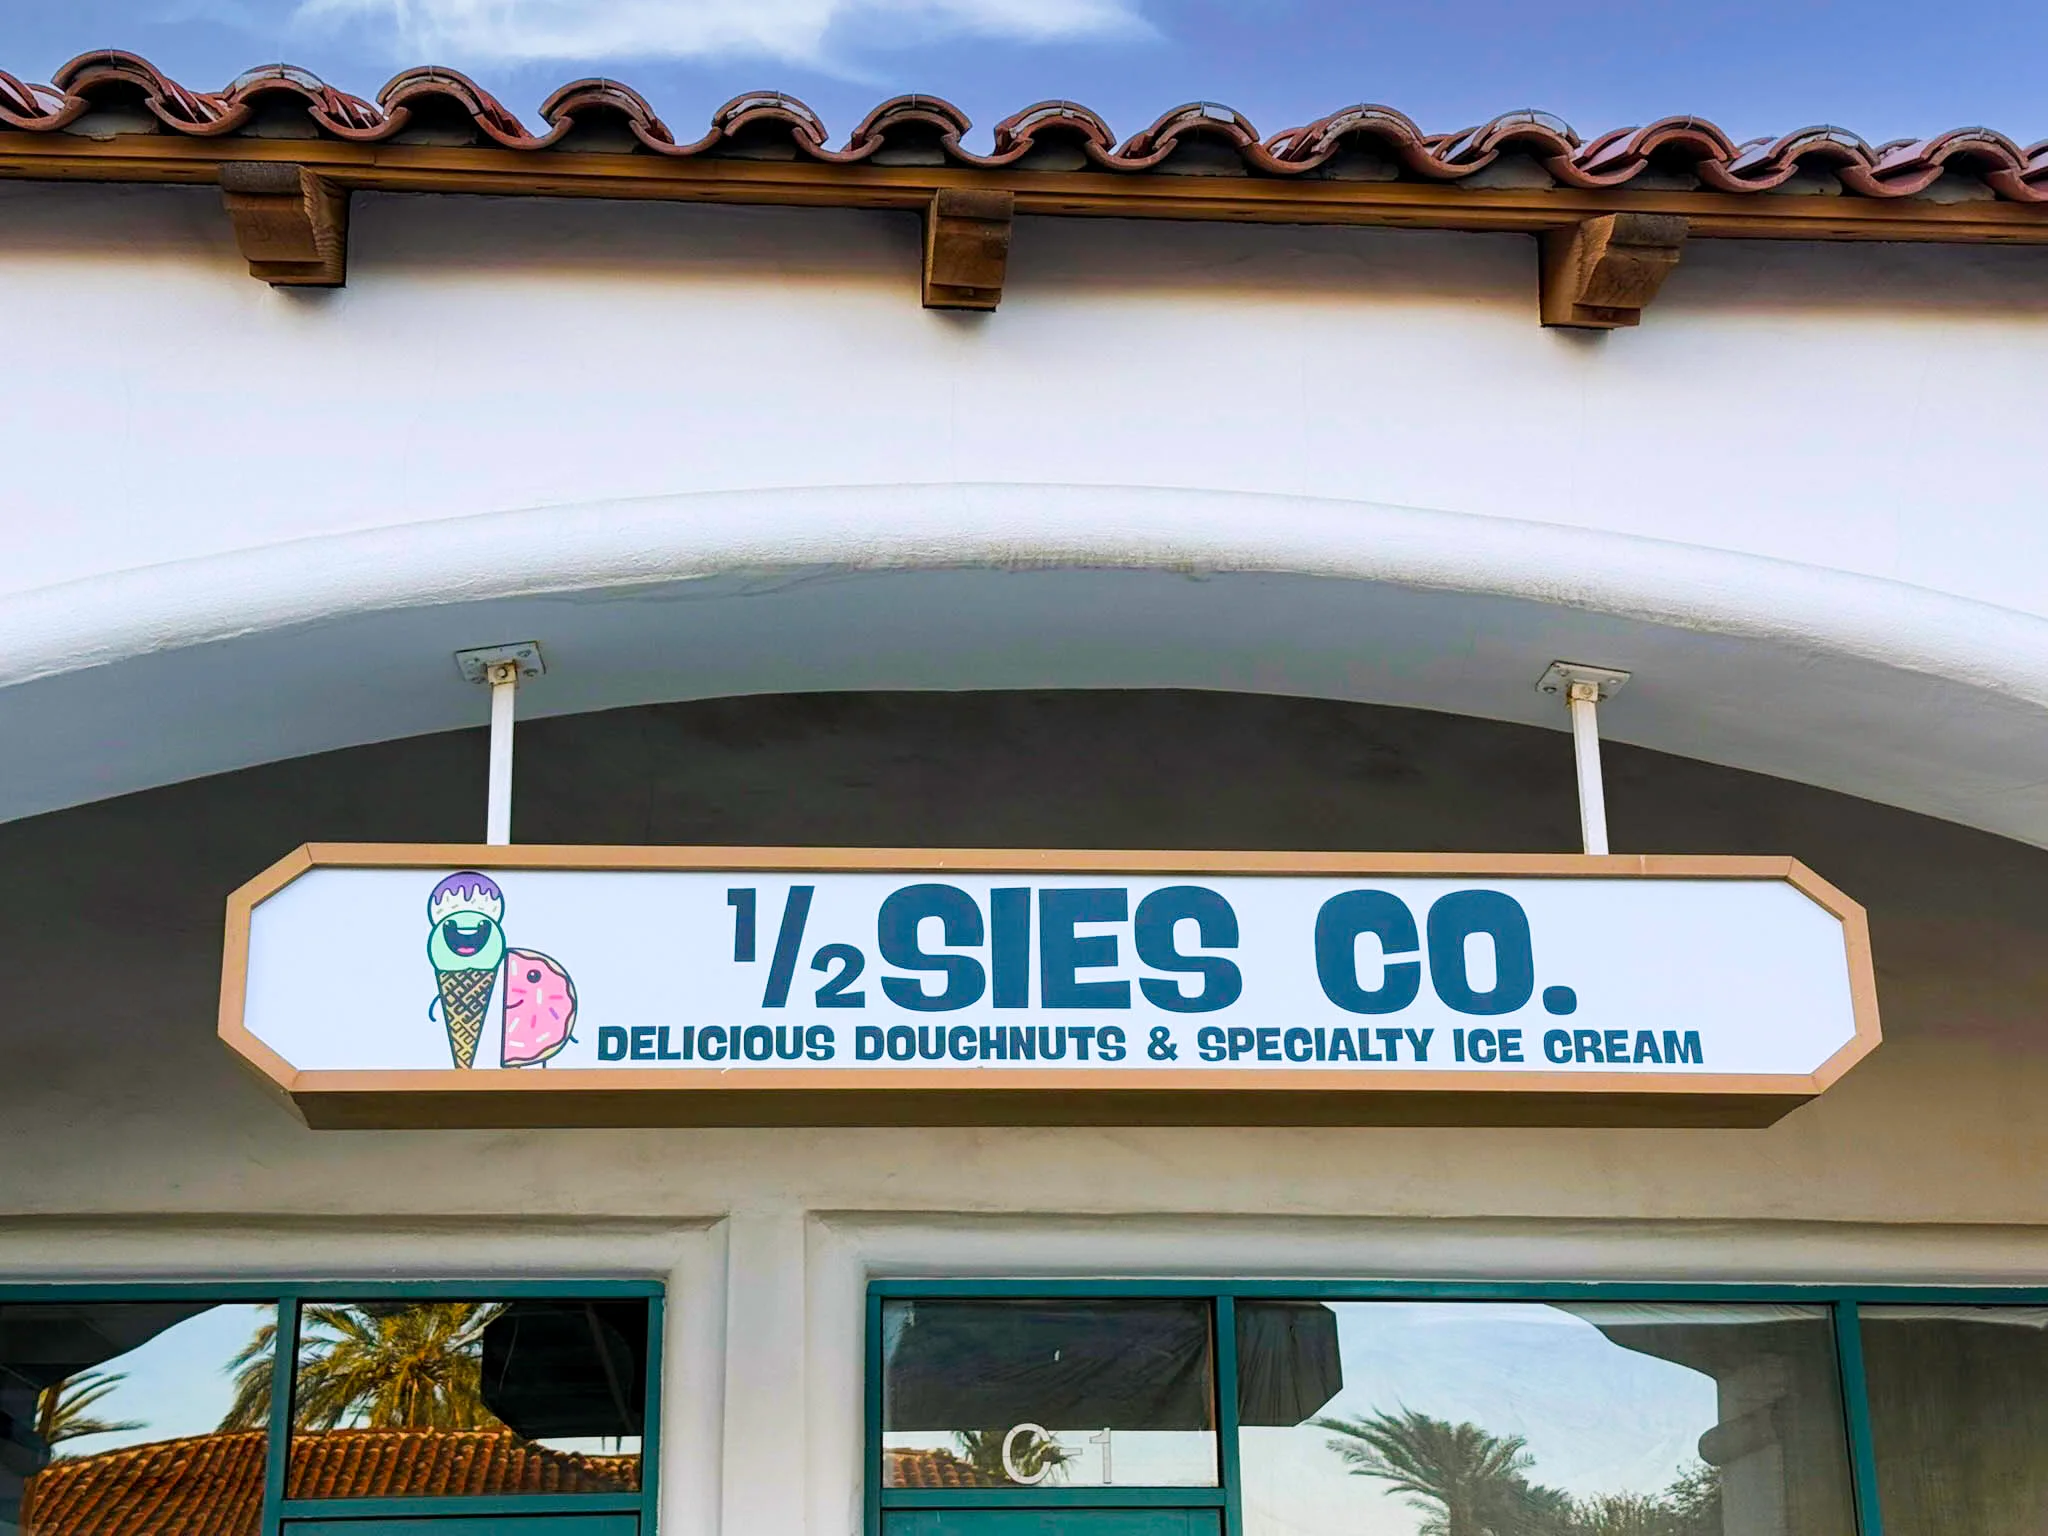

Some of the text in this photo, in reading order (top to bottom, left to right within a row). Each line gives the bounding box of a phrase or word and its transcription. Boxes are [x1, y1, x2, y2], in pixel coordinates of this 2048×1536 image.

[1314, 889, 1578, 1016] CO.
[597, 1024, 1704, 1065] DELICIOUS DOUGHNUTS & SPECIALTY ICE CREAM
[1002, 1422, 1112, 1485] C-1
